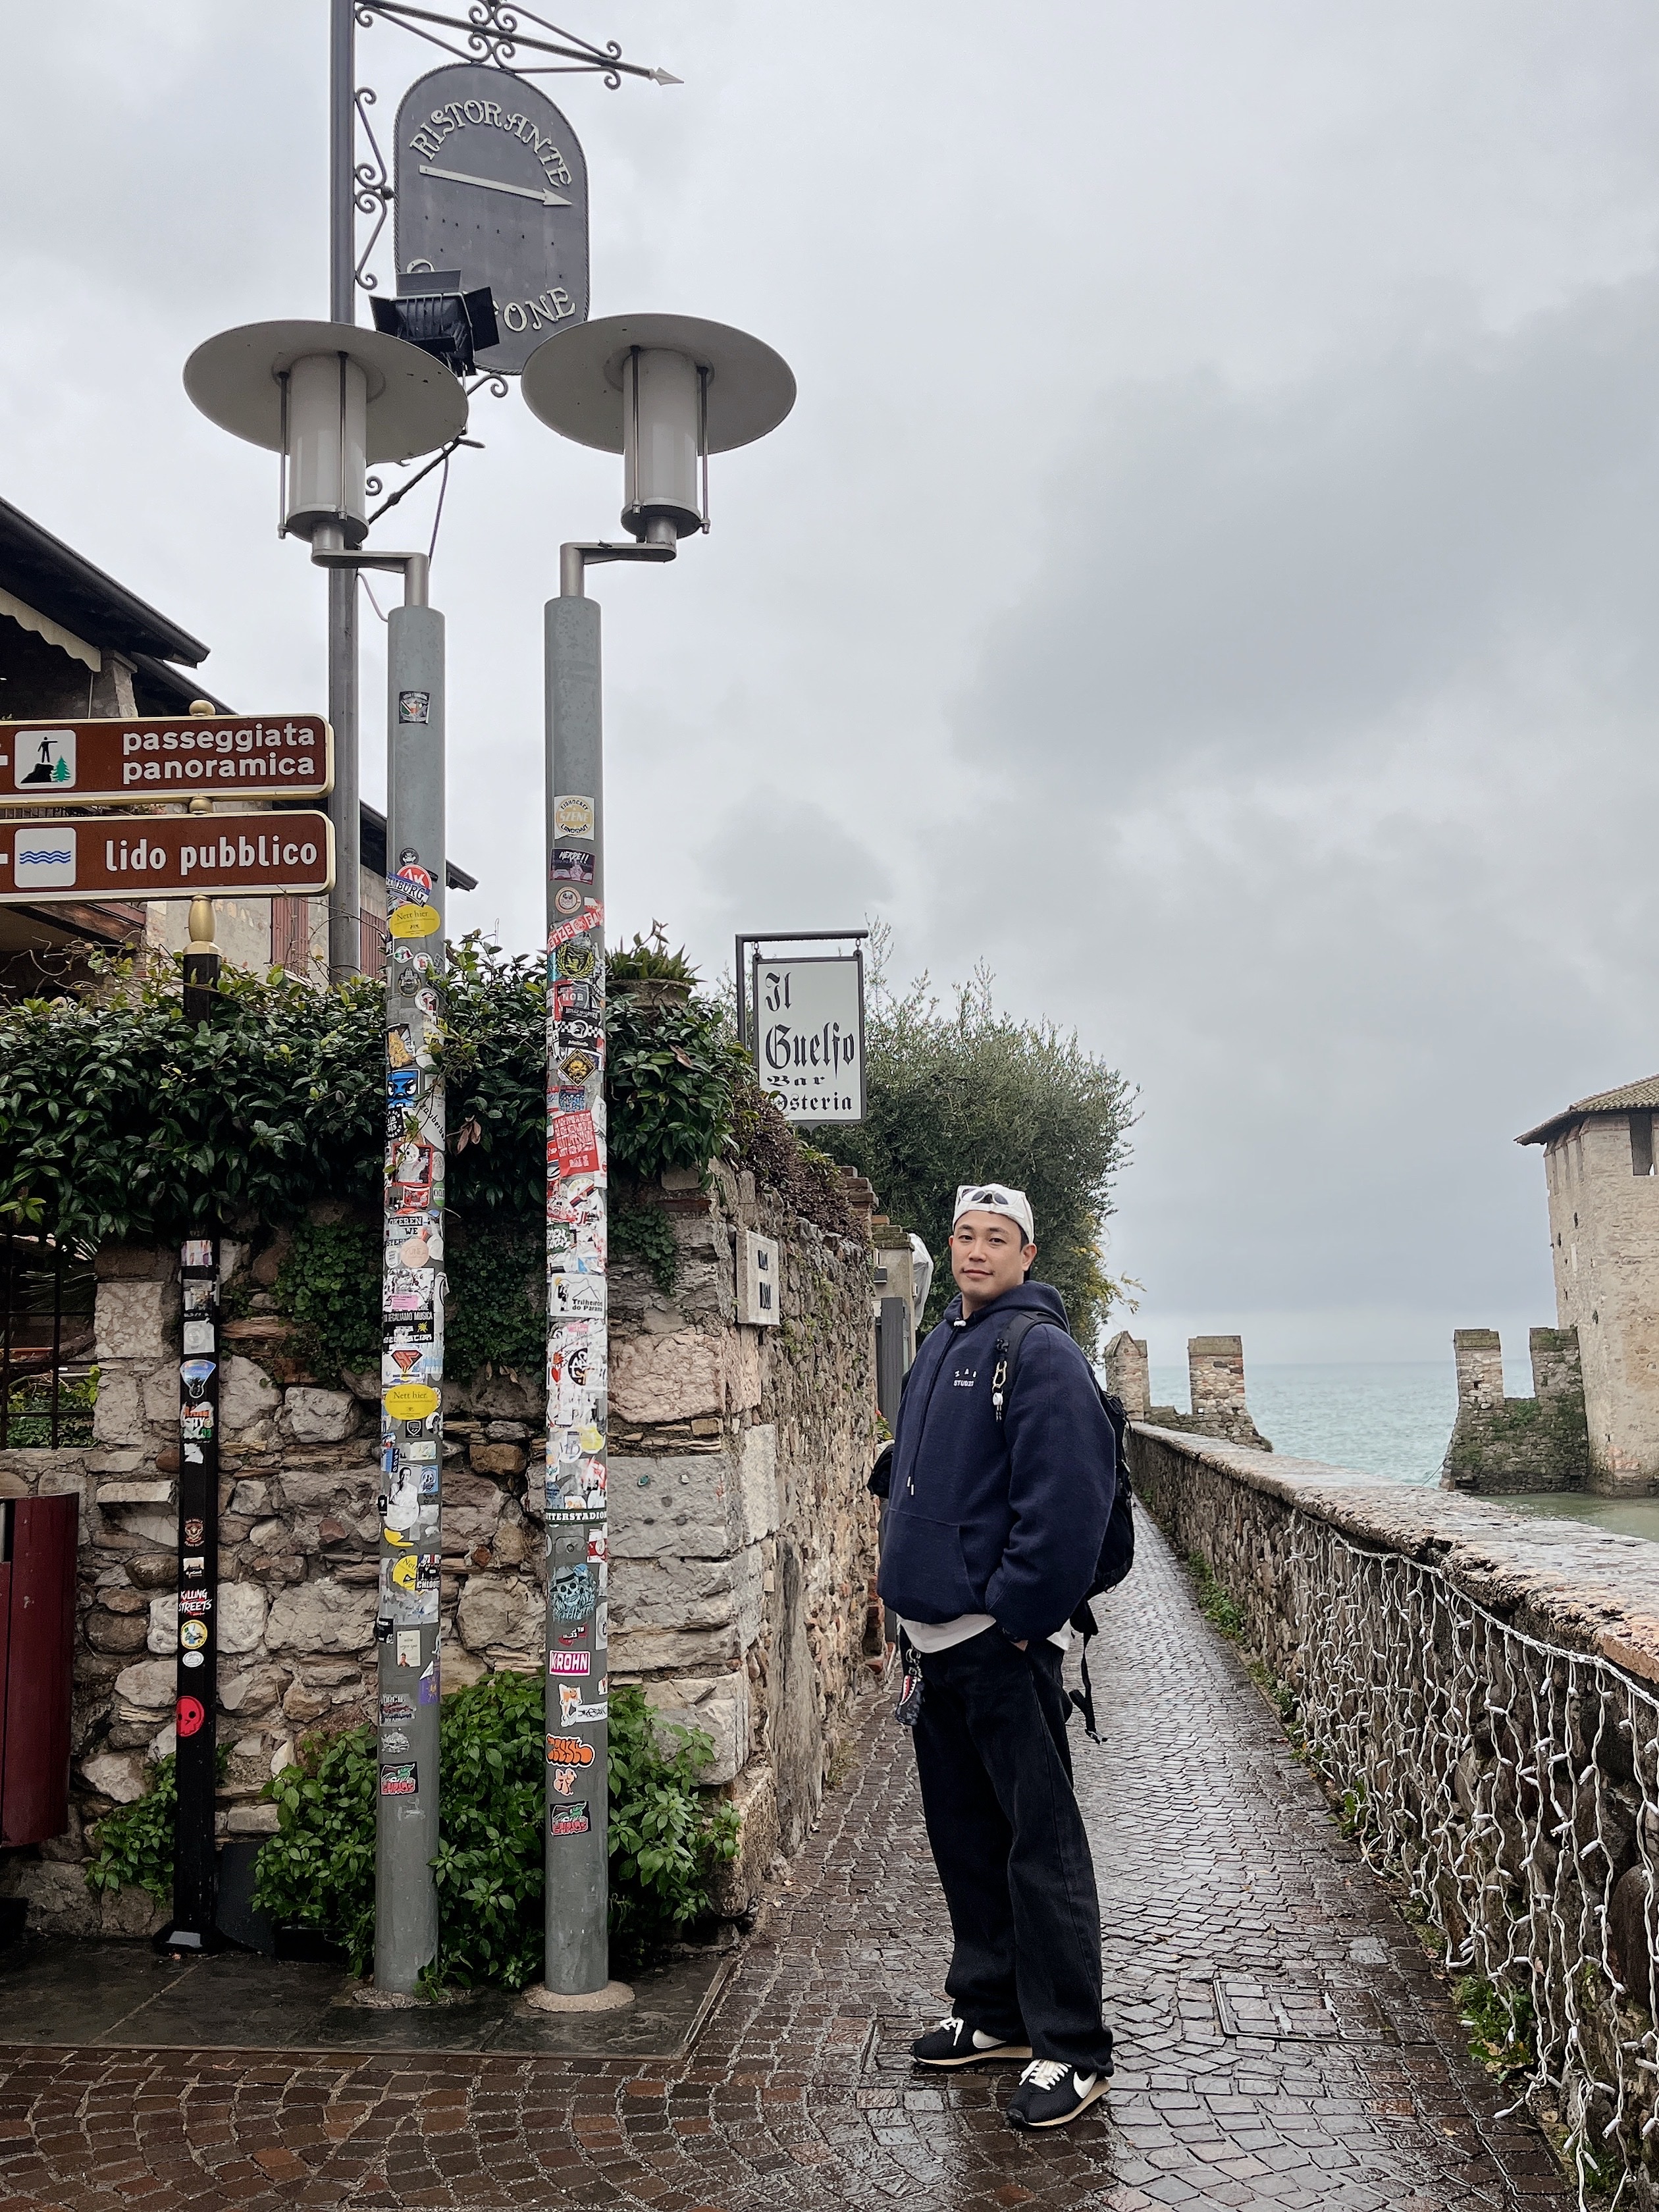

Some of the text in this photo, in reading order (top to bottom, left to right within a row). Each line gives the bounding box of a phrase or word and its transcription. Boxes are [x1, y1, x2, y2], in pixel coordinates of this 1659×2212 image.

[409, 99, 573, 188] RISTORANTE
[122, 722, 315, 756] passeggiata
[122, 752, 315, 785] panoramica
[559, 812, 589, 822] SZENE
[560, 824, 589, 833] LANDSHUT
[105, 834, 317, 876] lido pubblico
[396, 911, 412, 920] Nett
[764, 971, 792, 1012] Il
[765, 1022, 855, 1080] Guelfo
[766, 1075, 826, 1087] Bar
[412, 1390, 428, 1400] hier.
[180, 1589, 208, 1600] KILLING
[178, 1599, 213, 1614] STREETS
[550, 1652, 589, 1671] KROHN
